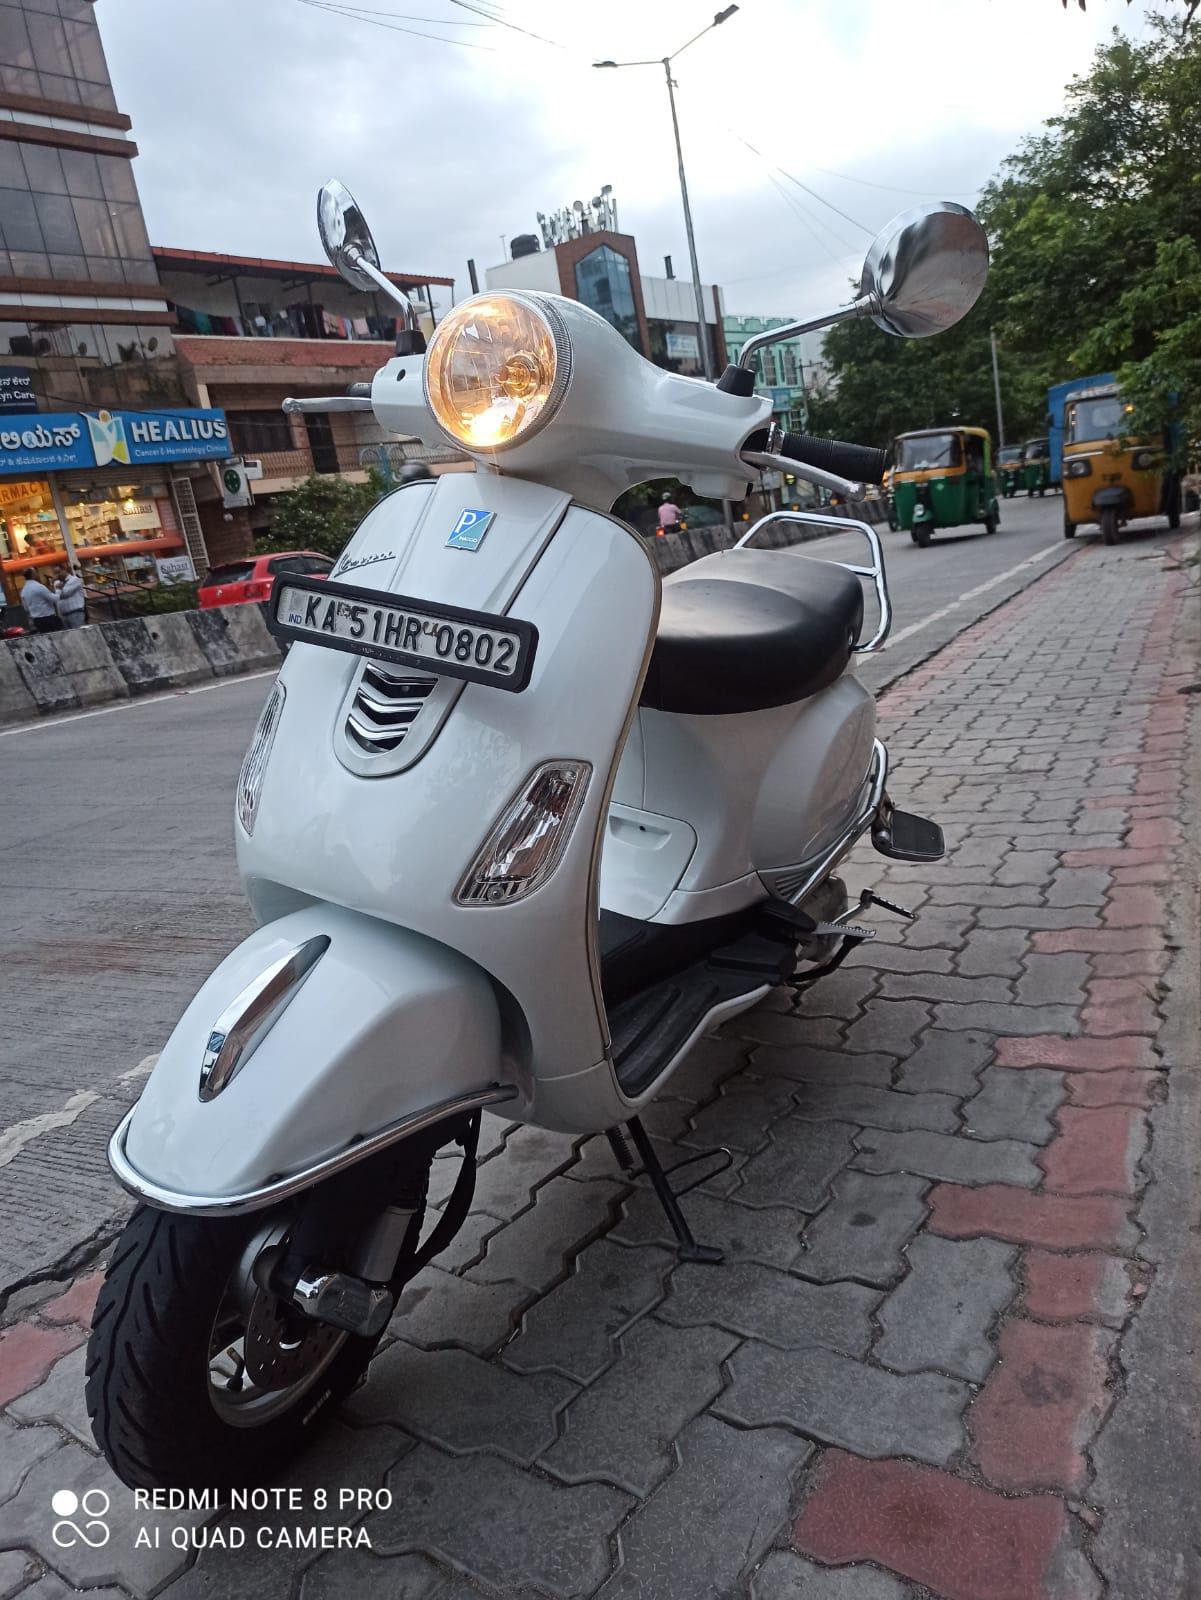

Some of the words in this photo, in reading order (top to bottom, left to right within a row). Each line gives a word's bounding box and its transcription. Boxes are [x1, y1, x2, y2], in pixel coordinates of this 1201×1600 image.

[13, 391, 36, 400] Care
[131, 419, 227, 443] HEALIUS
[454, 511, 477, 534] P
[288, 613, 303, 625] IND
[304, 595, 336, 632] KA
[435, 624, 515, 672] 0802
